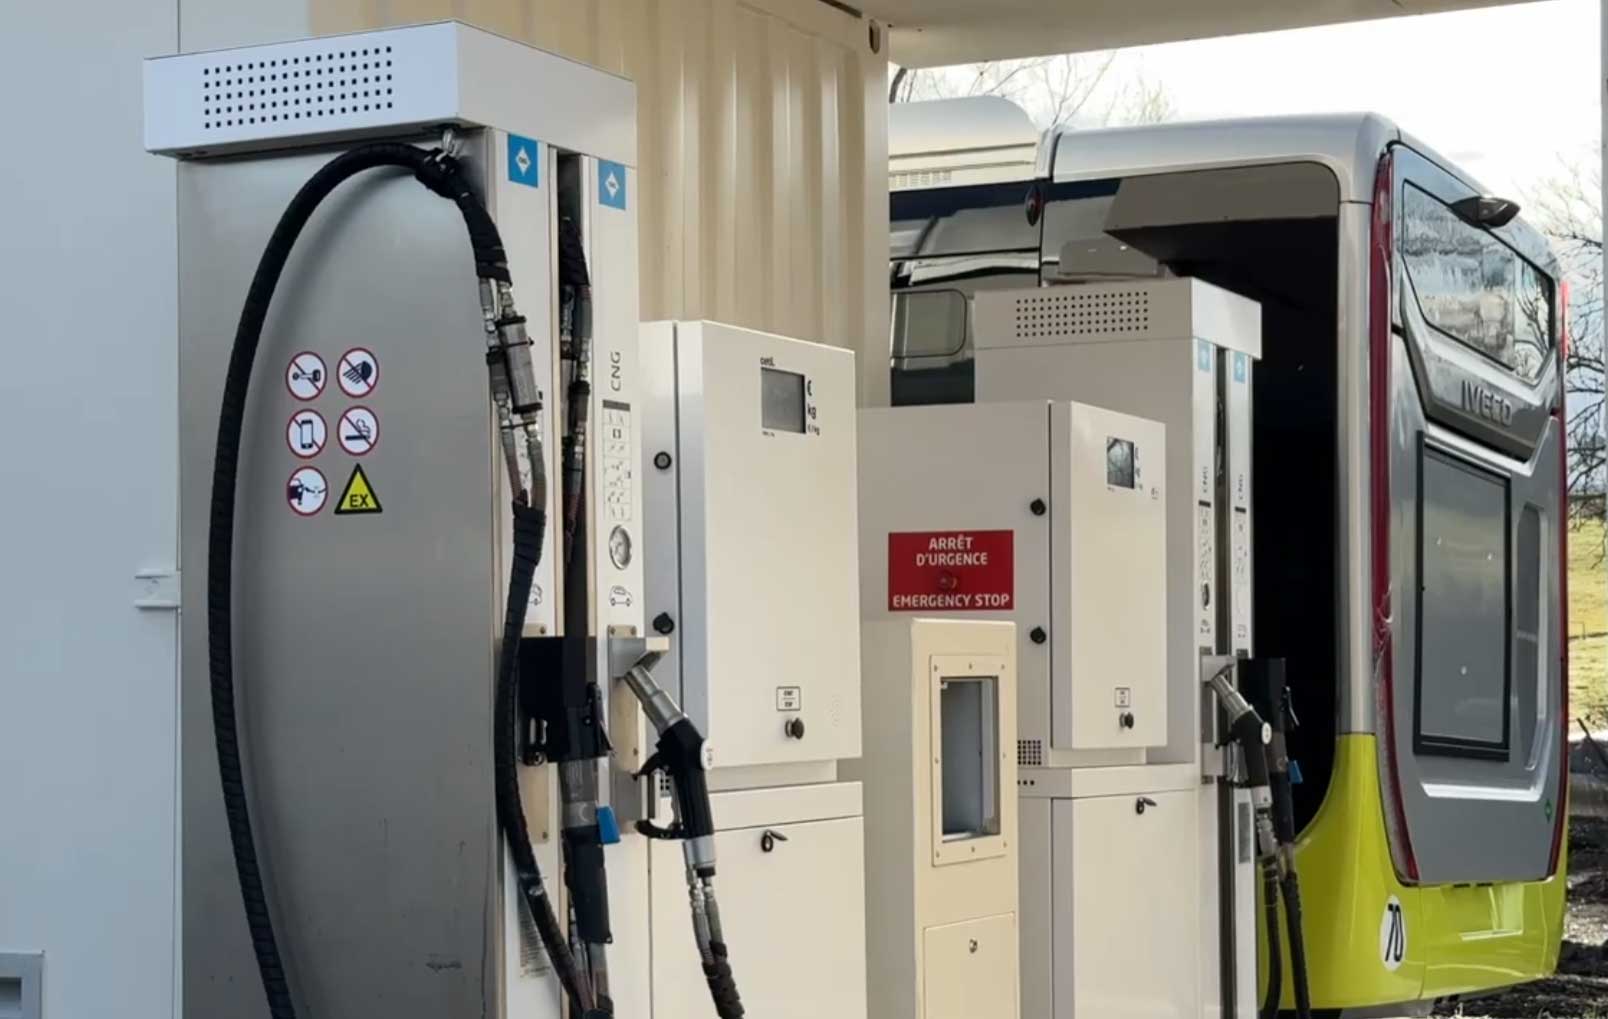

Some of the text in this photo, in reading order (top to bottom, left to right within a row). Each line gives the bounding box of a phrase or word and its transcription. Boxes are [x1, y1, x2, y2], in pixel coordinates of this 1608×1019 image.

[610, 351, 621, 392] CNG
[349, 493, 369, 508] EX
[928, 534, 973, 551] ARRÊT
[916, 552, 988, 567] D'URGENCE
[892, 593, 1010, 608] EMERGENCY STOP
[1384, 903, 1404, 962] 70
